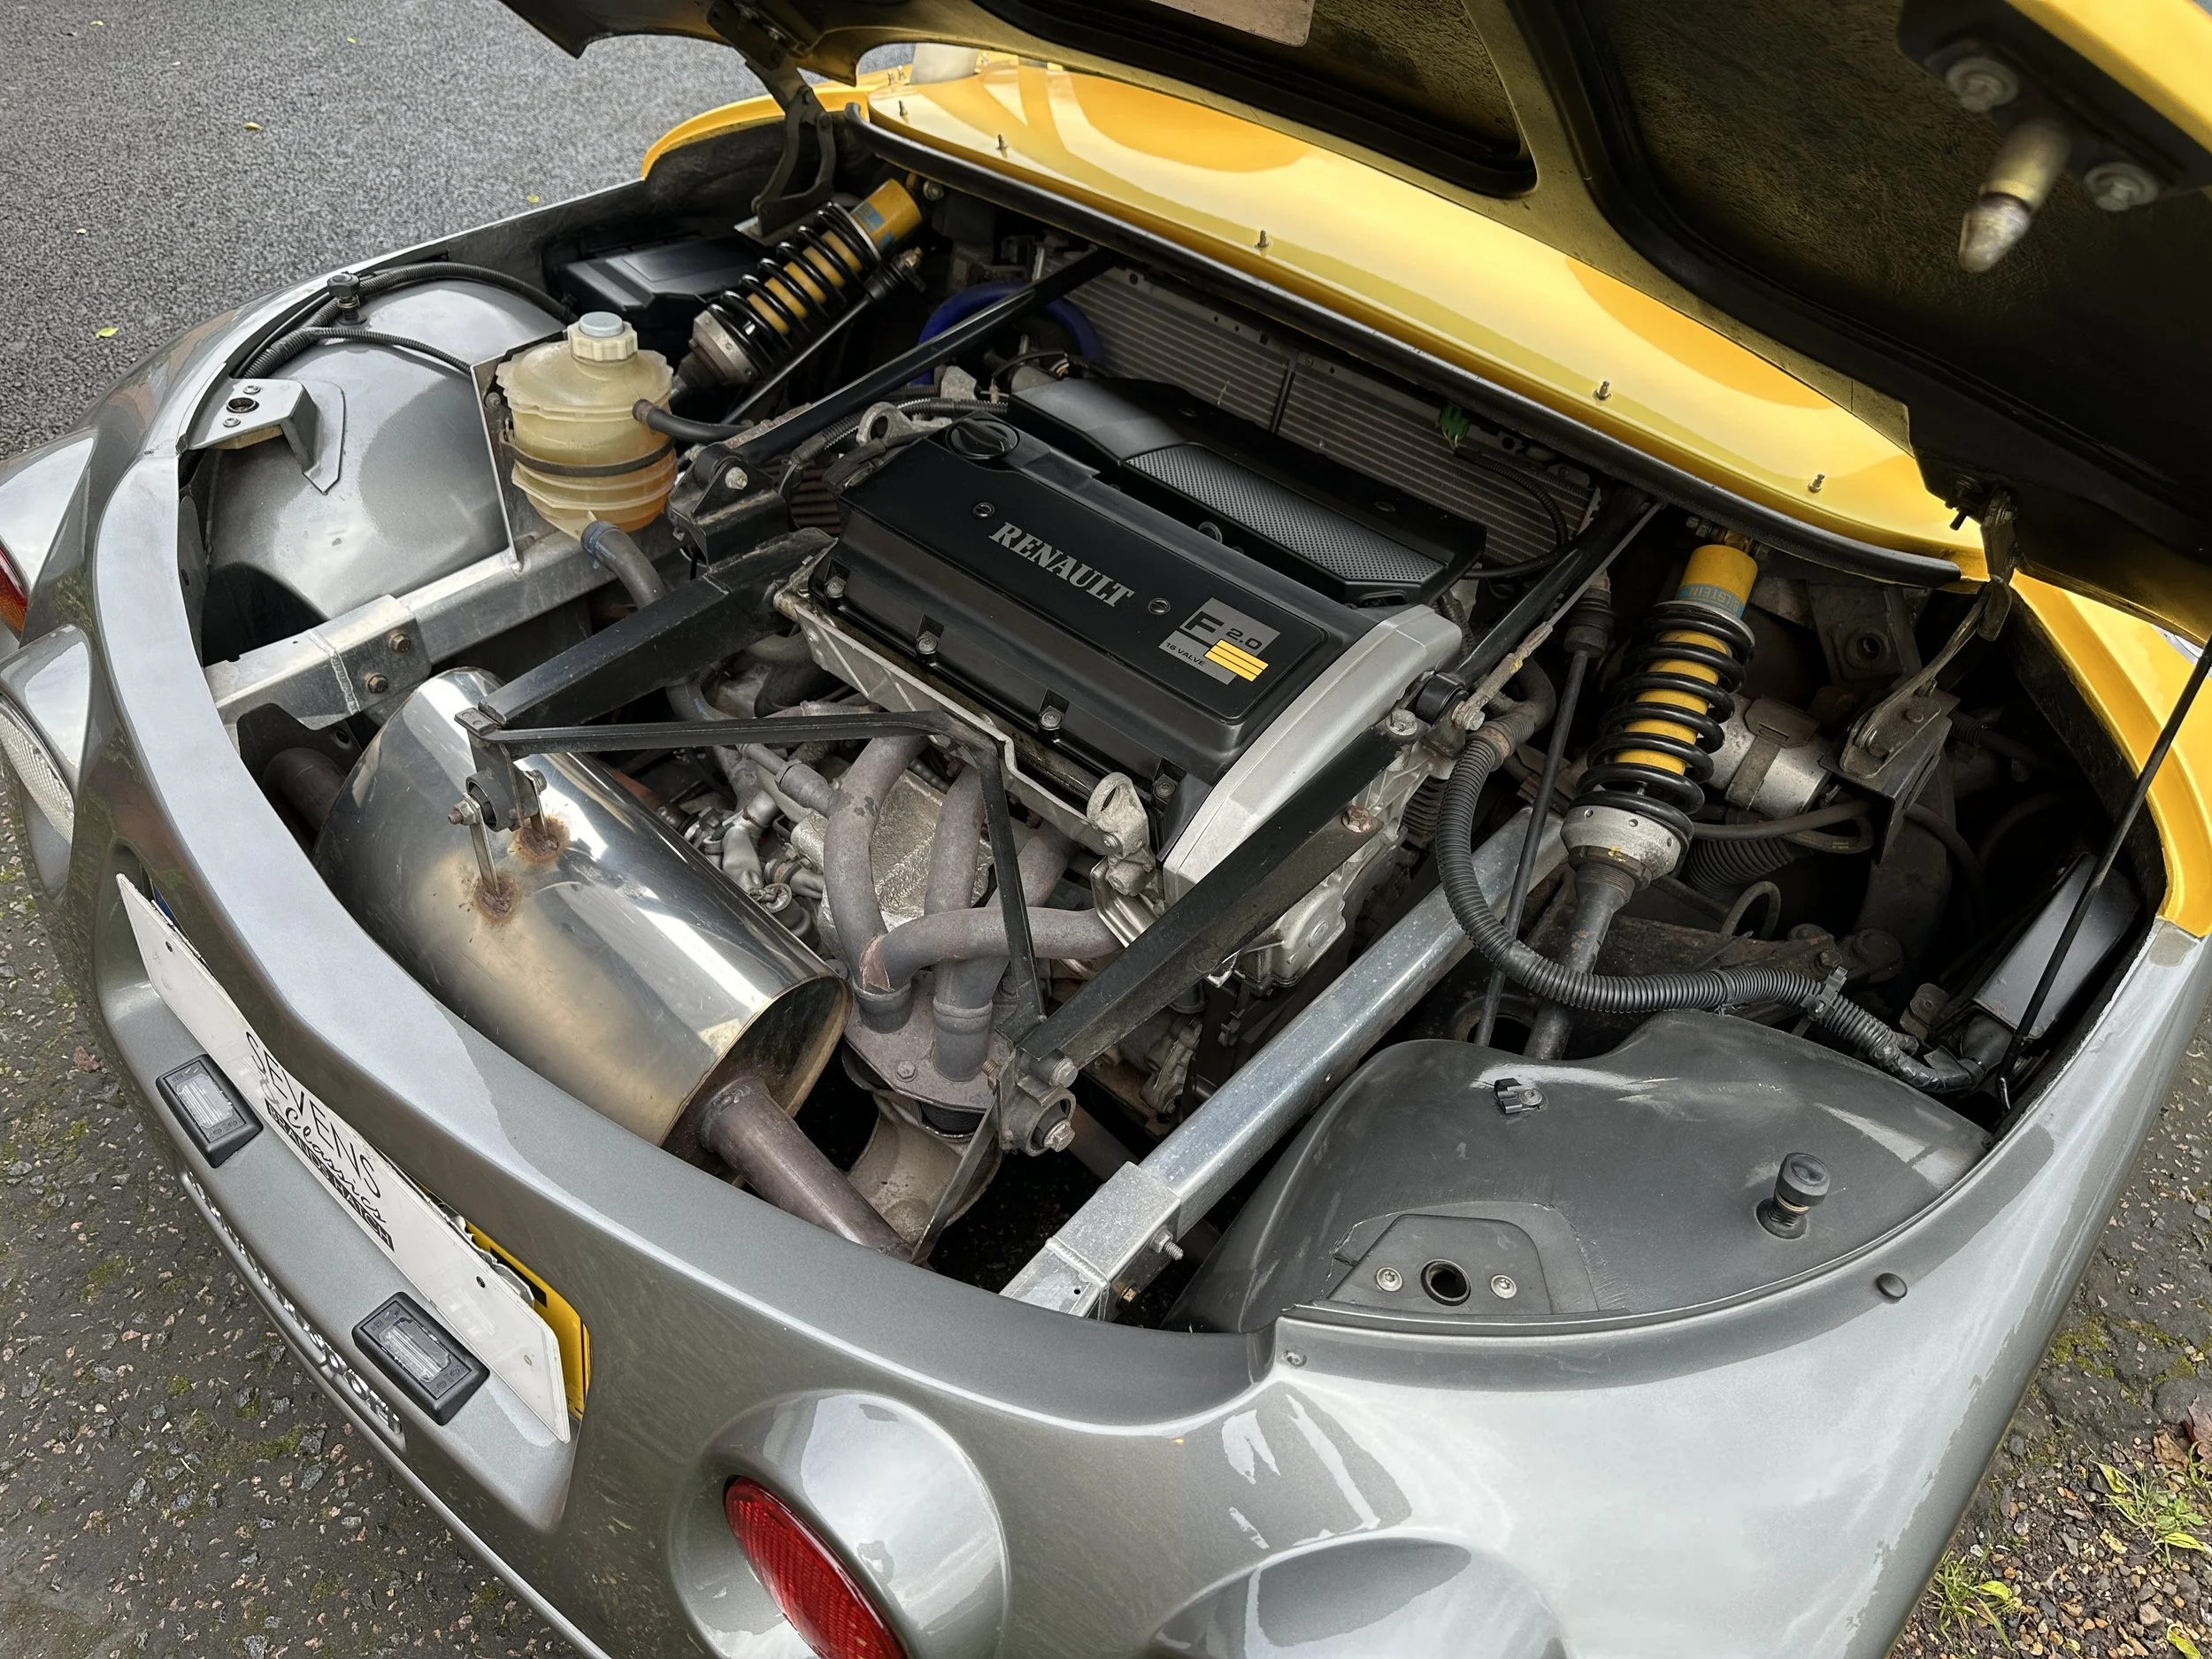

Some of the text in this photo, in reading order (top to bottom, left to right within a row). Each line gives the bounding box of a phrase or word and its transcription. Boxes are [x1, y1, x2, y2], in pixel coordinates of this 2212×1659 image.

[988, 521, 1135, 608] RENAULT
[1689, 586, 1741, 612] BILSTEIN
[1165, 642, 1206, 666] 16 VALVE
[1184, 611, 1263, 650] F 2.0
[245, 1031, 381, 1199] SEVENS
[267, 1102, 332, 1184] BRANDS
[334, 1180, 394, 1250] HATCH
[285, 1106, 387, 1224] Classics
